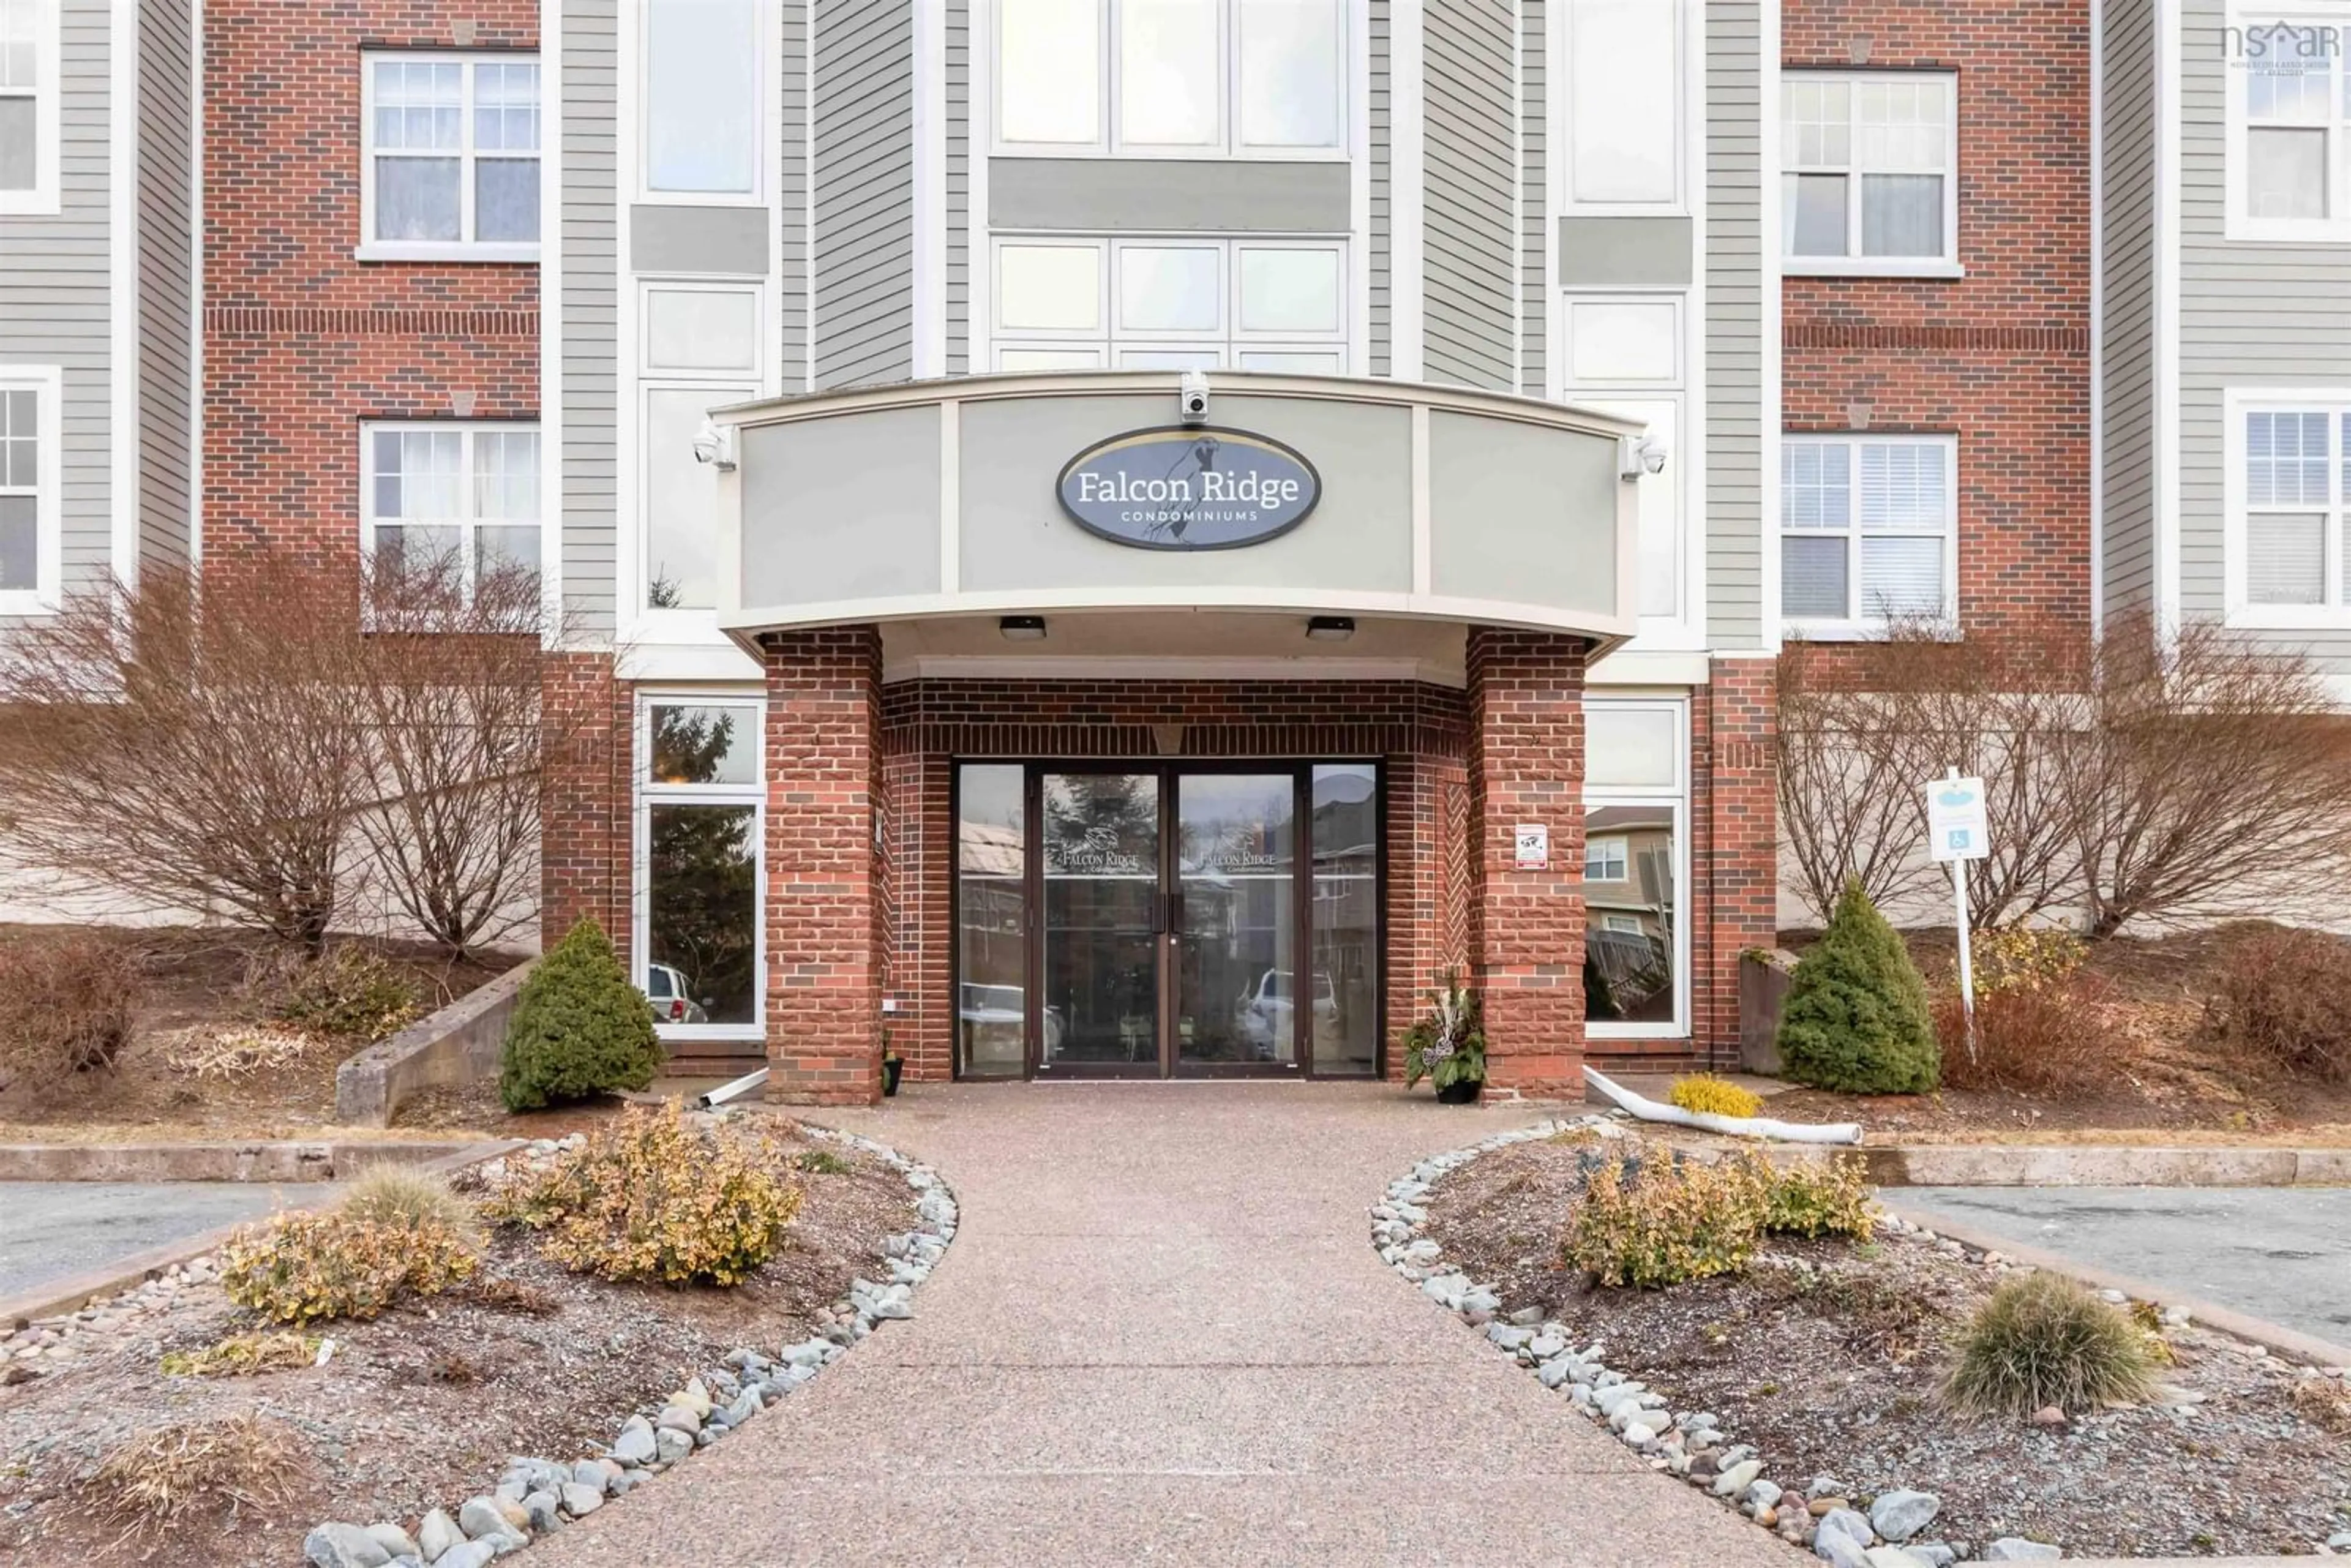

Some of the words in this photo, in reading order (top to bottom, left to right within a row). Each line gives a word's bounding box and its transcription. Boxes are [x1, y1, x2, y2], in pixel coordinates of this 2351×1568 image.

[1078, 471, 1189, 502] Falcon
[1201, 471, 1299, 509] Ridge
[1121, 511, 1258, 522] CONDOMINIUMS
[1063, 850, 1103, 865] FALCON
[1106, 850, 1139, 865] RIDGE
[1200, 850, 1240, 865] FALCON
[1243, 850, 1275, 865] RIDGE
